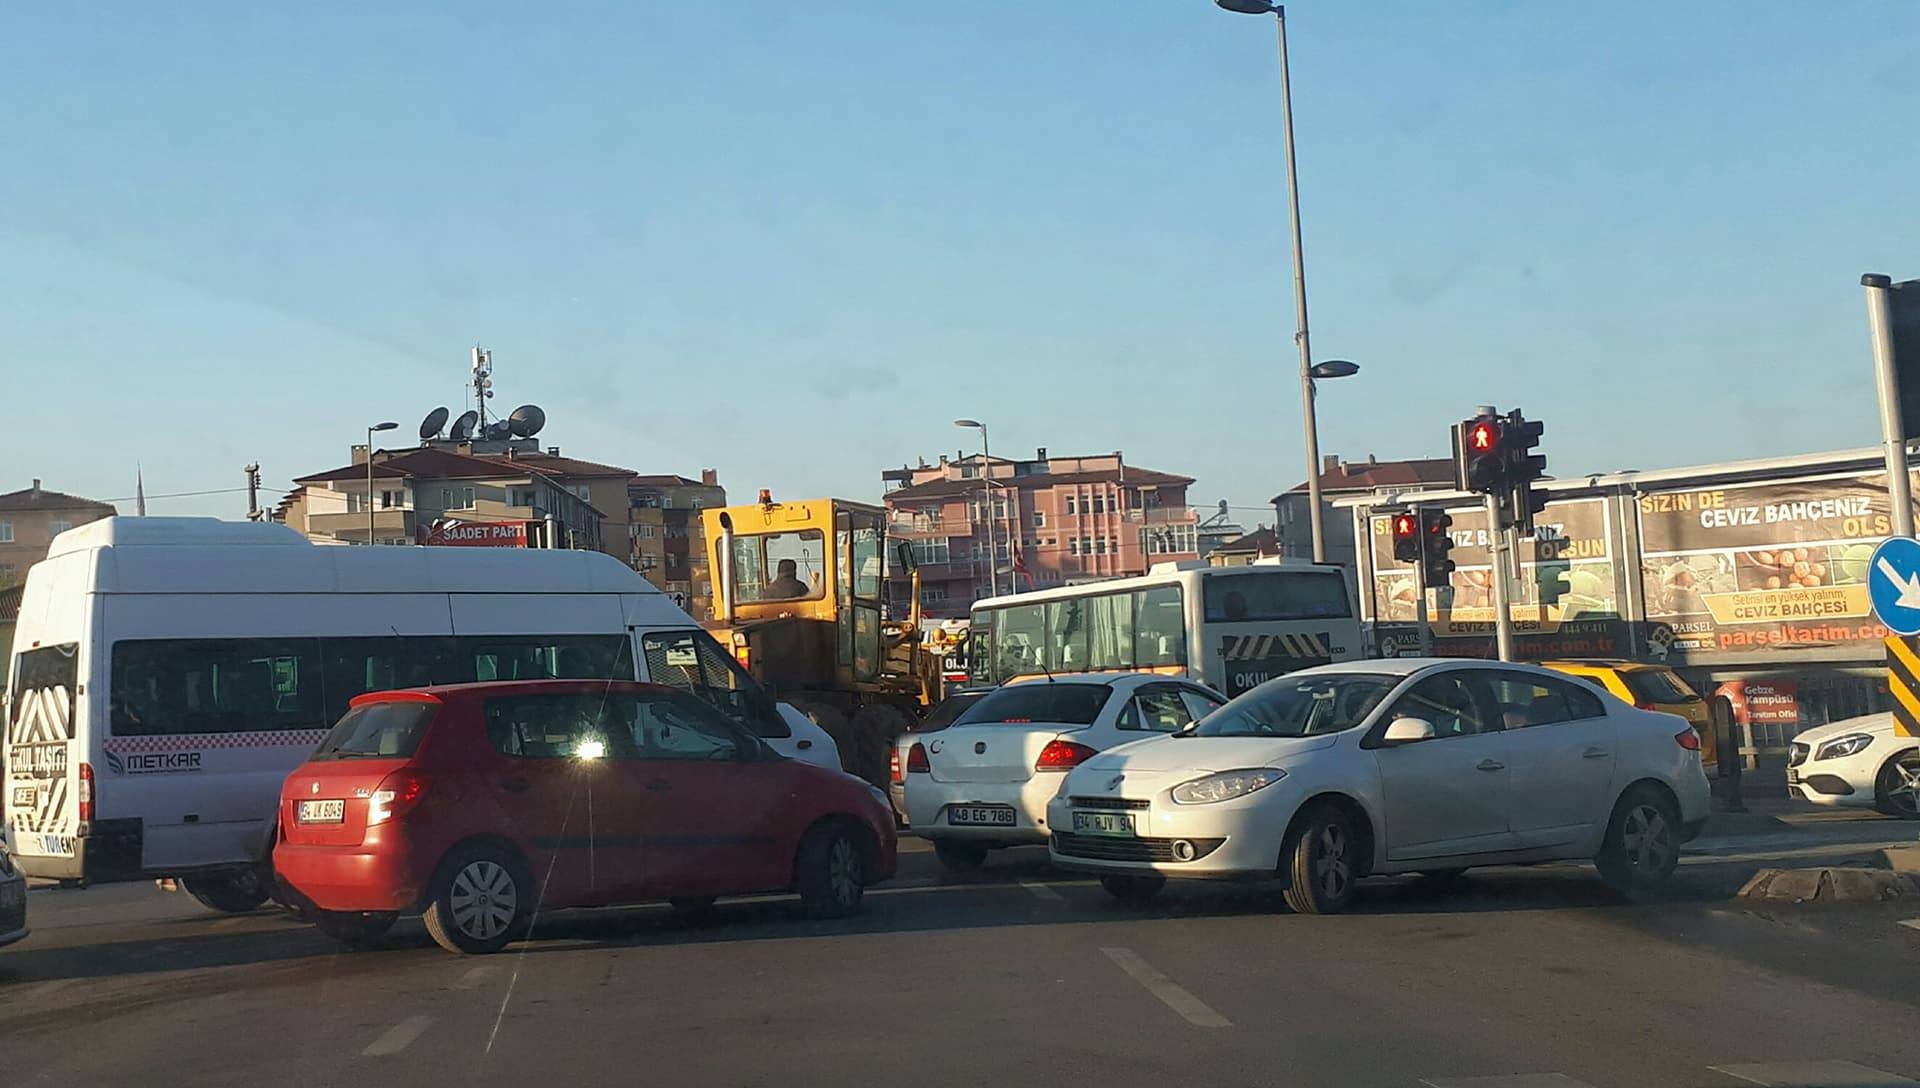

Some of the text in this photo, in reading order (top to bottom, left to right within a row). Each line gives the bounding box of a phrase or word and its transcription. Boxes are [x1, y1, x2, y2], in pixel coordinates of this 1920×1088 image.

[1698, 491, 1725, 510] DE
[443, 527, 489, 540] SAADET
[1672, 621, 1714, 633] PARSEL
[1744, 685, 1775, 695] Gebze
[1745, 694, 1794, 707] Kampüsü
[1778, 709, 1798, 718] Ofisi
[128, 752, 201, 769] METKAR
[955, 809, 1013, 822] 48 EG 786
